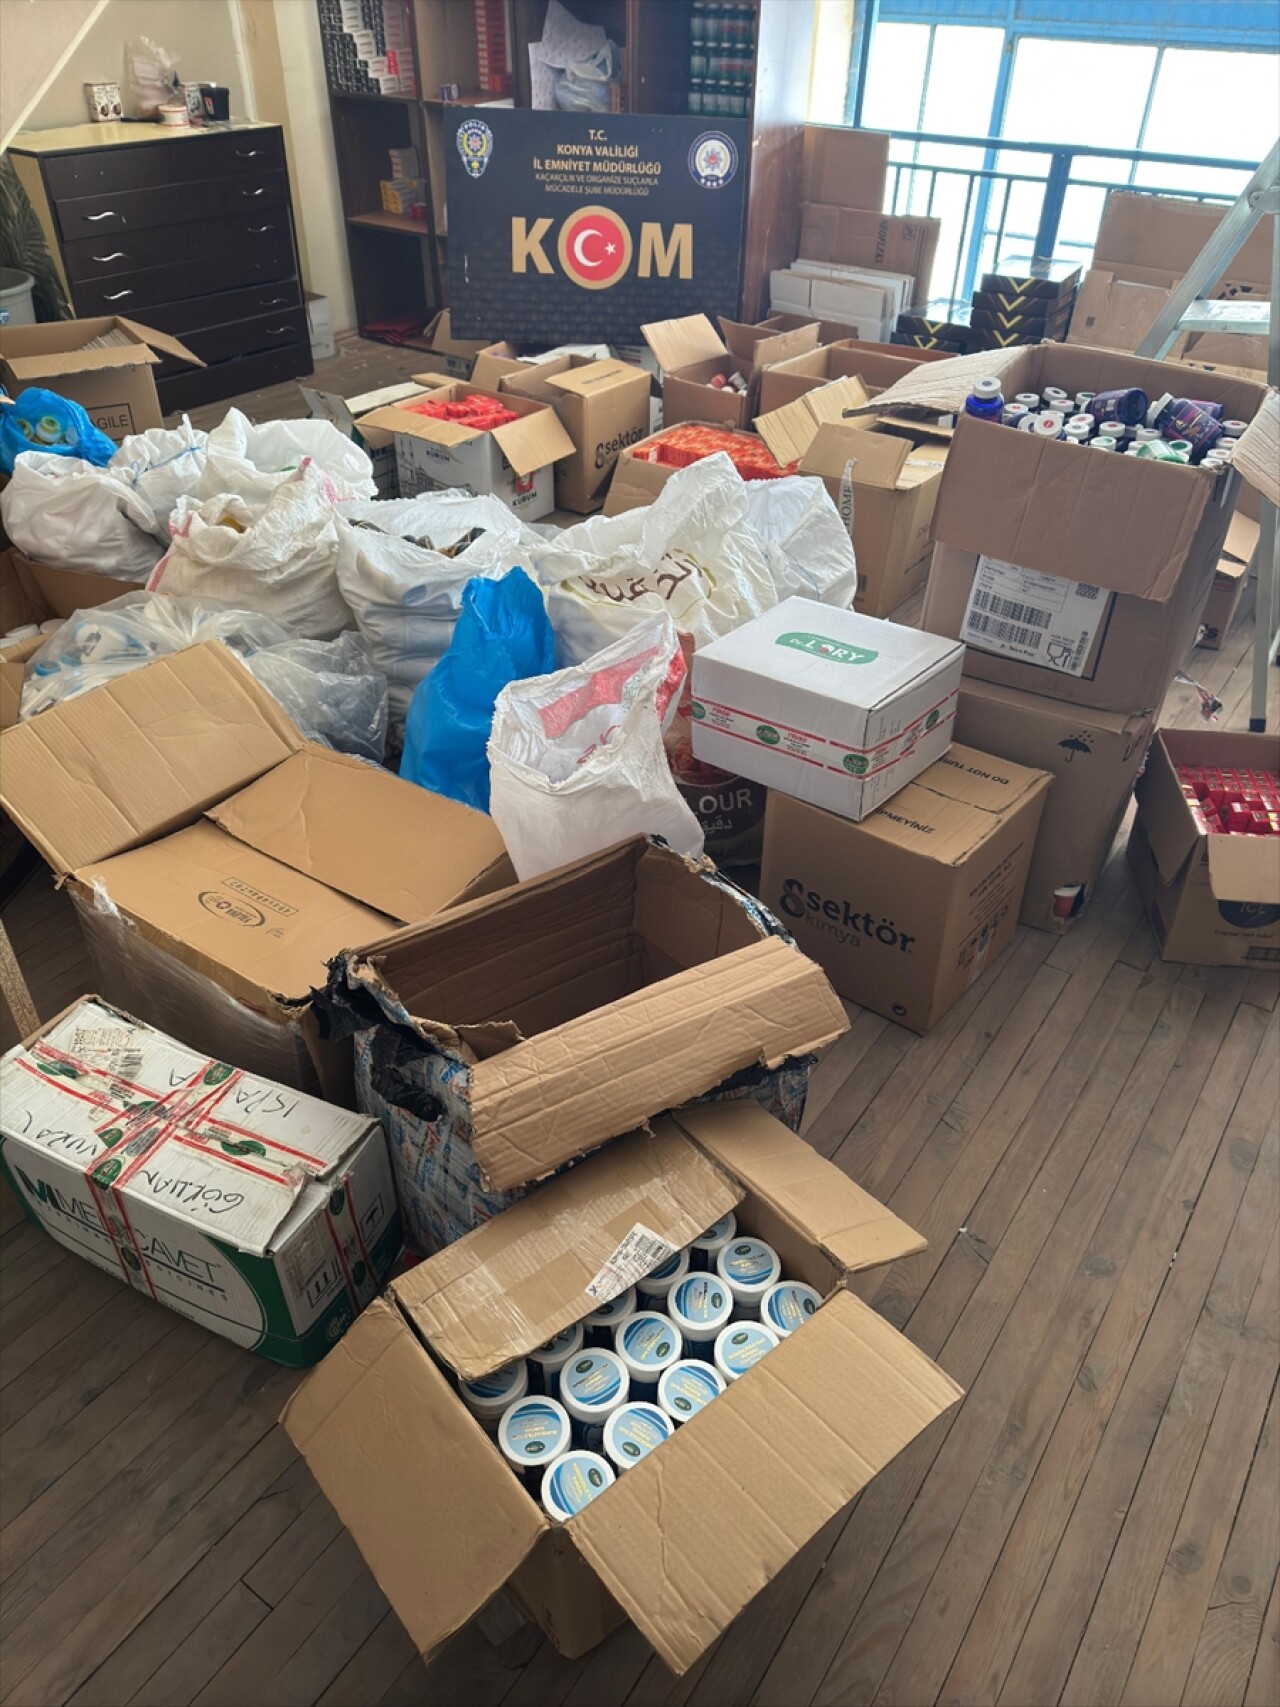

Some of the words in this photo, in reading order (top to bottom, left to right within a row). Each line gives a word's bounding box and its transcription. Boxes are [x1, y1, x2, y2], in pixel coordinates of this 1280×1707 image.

[588, 129, 607, 141] T.C.
[557, 144, 593, 156] KONYA
[595, 145, 639, 158] VALİLİĞİ
[533, 156, 543, 170] İL
[544, 158, 590, 172] EMNİYET
[592, 160, 661, 175] MÜDÜRLÜĞÜ
[576, 175, 585, 183] VE
[623, 177, 659, 186] SUÇLARLA
[545, 183, 583, 193] MÜCADELE
[585, 186, 602, 195] ŞUBE
[603, 186, 649, 196] MÜDÜRLÜĞÜ
[511, 205, 693, 290] KOM
[966, 767, 991, 780] NOT
[992, 775, 1010, 785] DO
